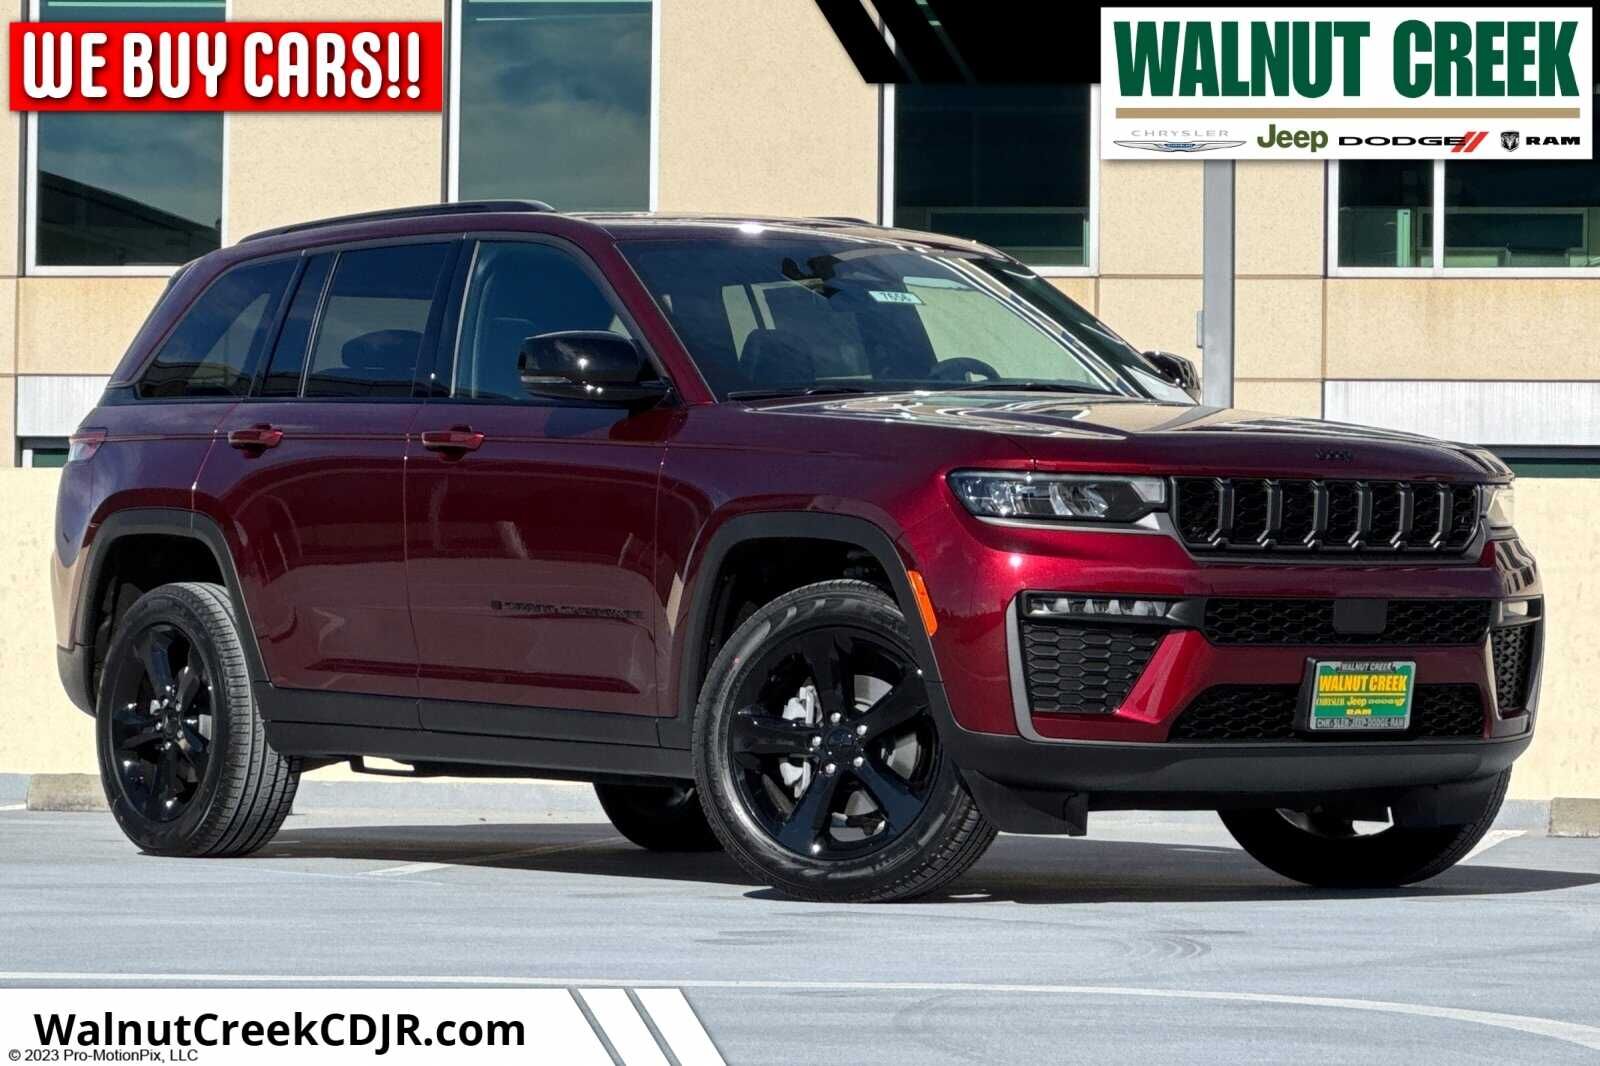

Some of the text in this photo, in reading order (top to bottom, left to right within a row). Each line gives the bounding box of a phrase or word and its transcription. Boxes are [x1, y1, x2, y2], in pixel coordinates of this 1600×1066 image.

[1341, 662, 1392, 671] WALNUT CREEK
[1319, 675, 1408, 691] WALNUT CREEK
[1346, 697, 1367, 707] Jeep
